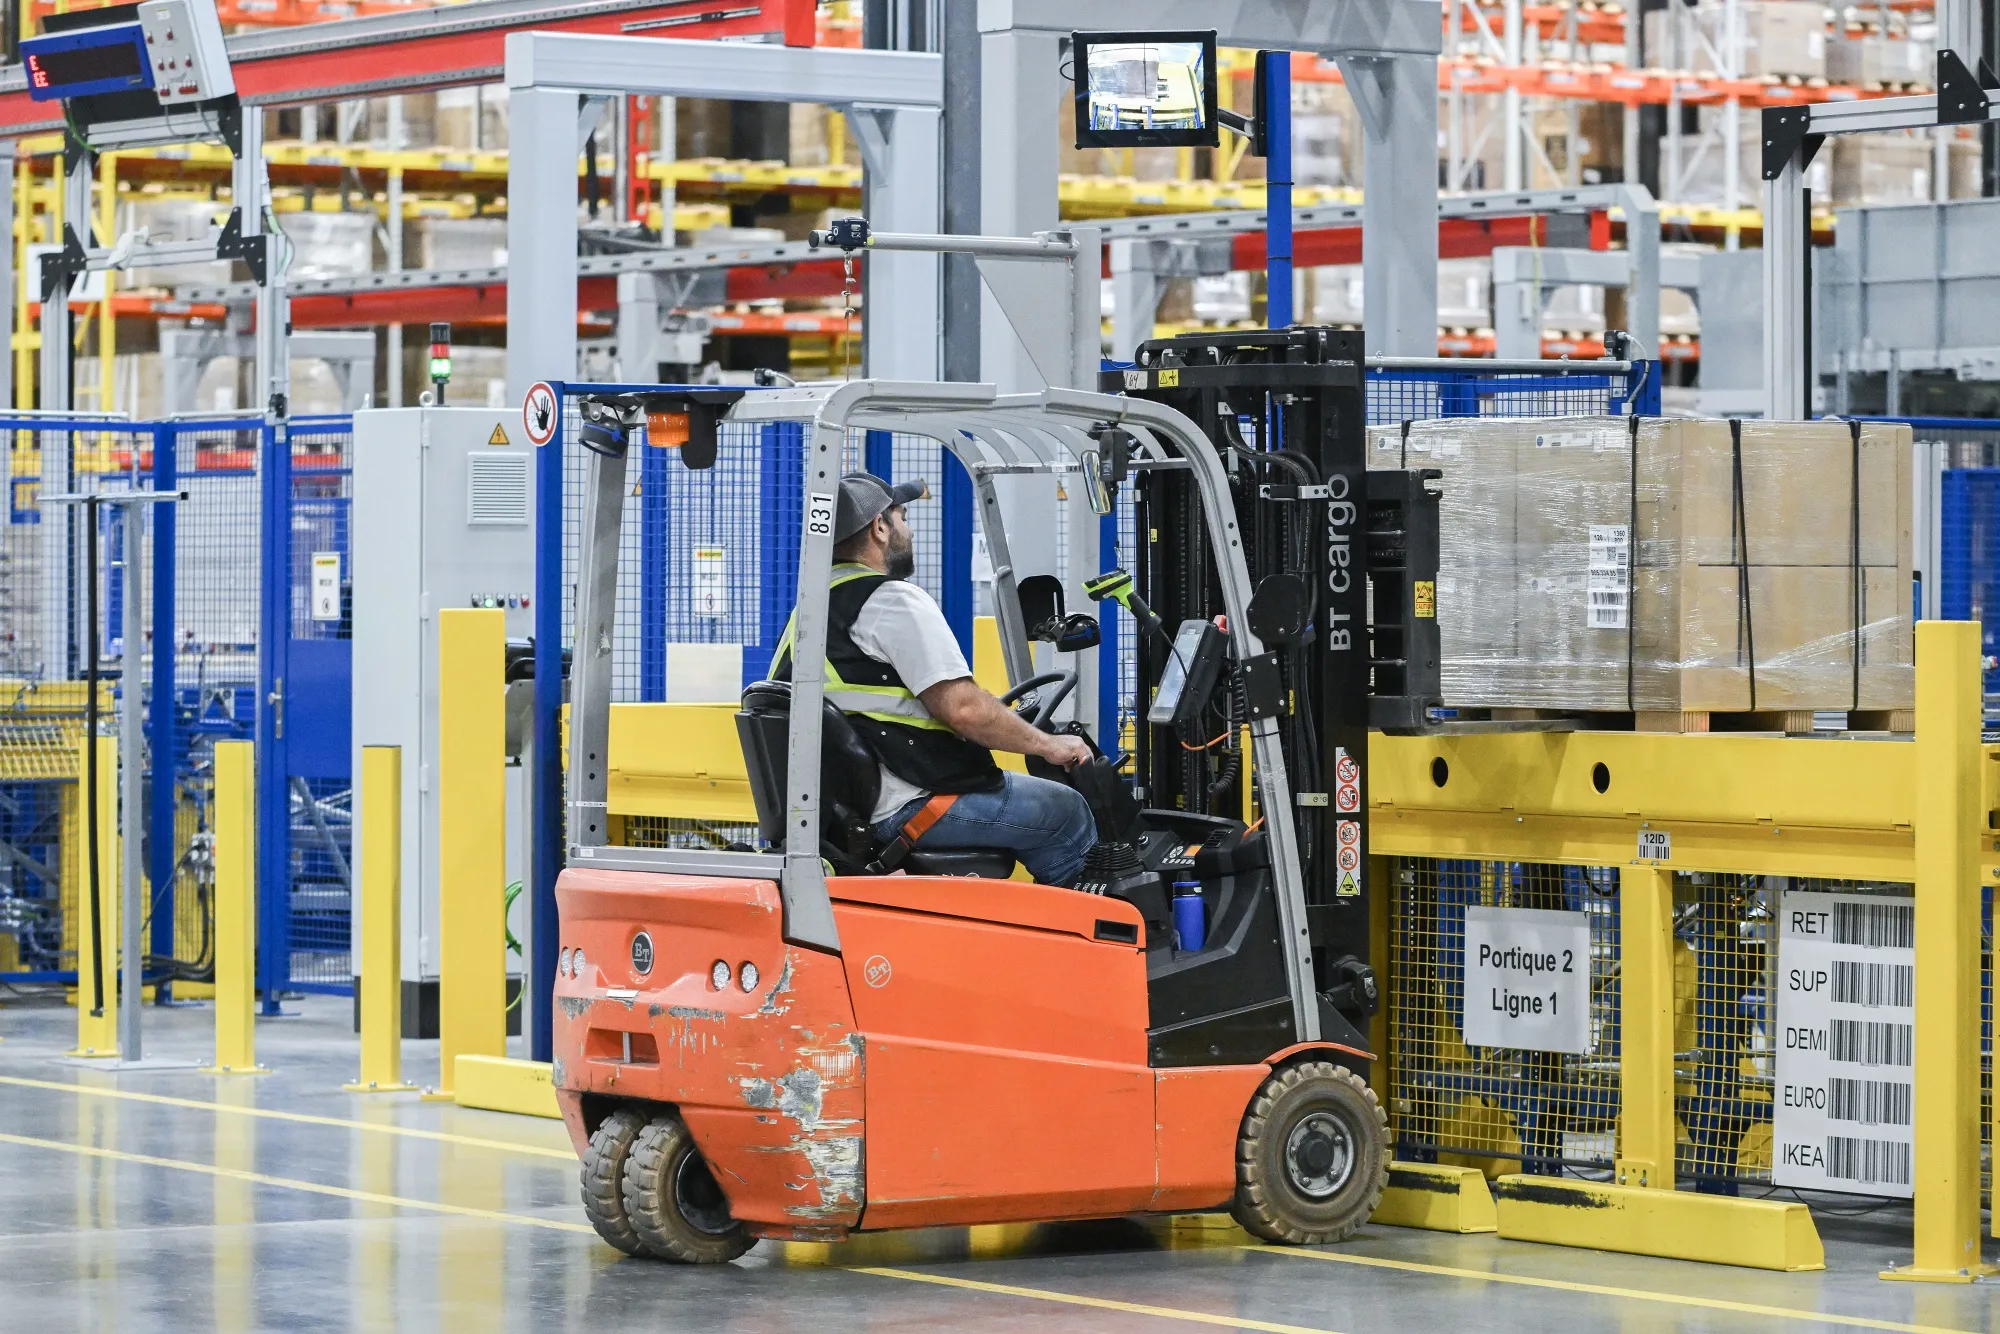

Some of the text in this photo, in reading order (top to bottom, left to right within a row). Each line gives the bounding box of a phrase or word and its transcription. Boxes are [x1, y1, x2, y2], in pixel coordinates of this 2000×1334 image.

[810, 496, 831, 534] 831
[1327, 473, 1357, 651] BT cargo
[1644, 833, 1665, 844] 12ID
[1792, 911, 1829, 934] RET
[634, 942, 650, 962] BT
[1480, 944, 1573, 976] Portique 2
[868, 962, 888, 980] BT
[1789, 969, 1828, 992] SUP
[1492, 988, 1557, 1018] Ligne 1
[1786, 1027, 1827, 1051] DEMI
[1784, 1085, 1826, 1109] EURO
[1783, 1143, 1825, 1168] IKEA
